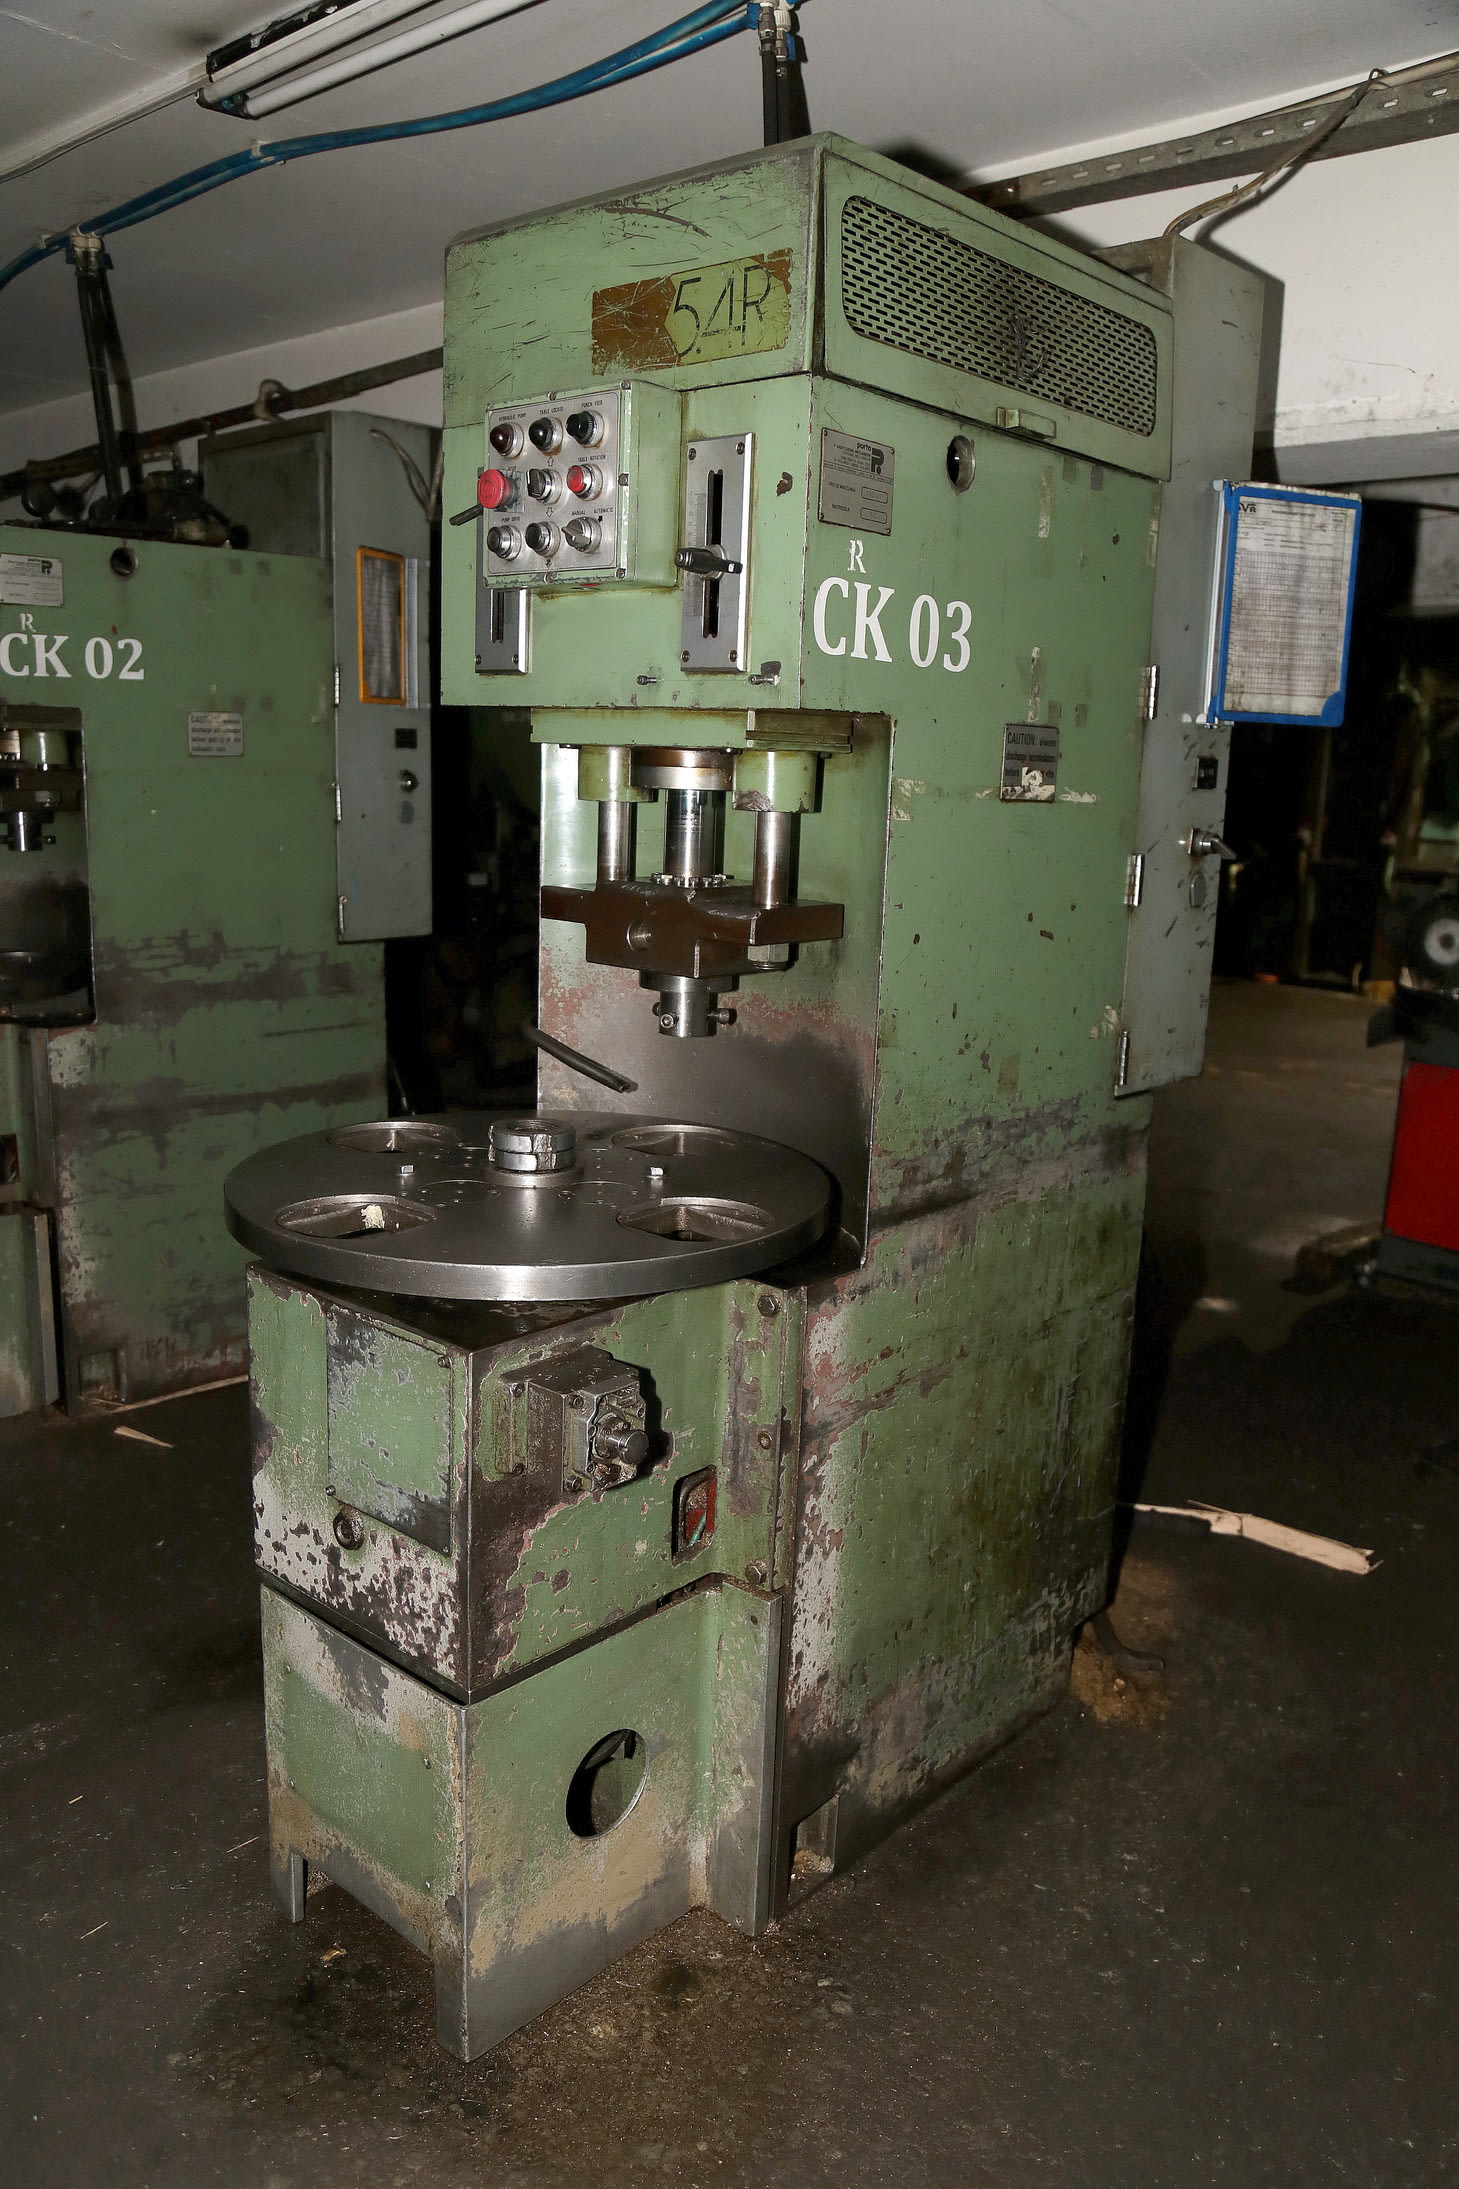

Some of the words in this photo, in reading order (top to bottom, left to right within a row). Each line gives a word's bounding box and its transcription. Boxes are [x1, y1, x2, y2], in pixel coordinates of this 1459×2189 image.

[848, 539, 866, 573] R
[20, 613, 36, 632] R
[813, 577, 895, 662] CK
[909, 594, 972, 672] 03
[0, 633, 72, 678] CK
[85, 637, 145, 680] 02
